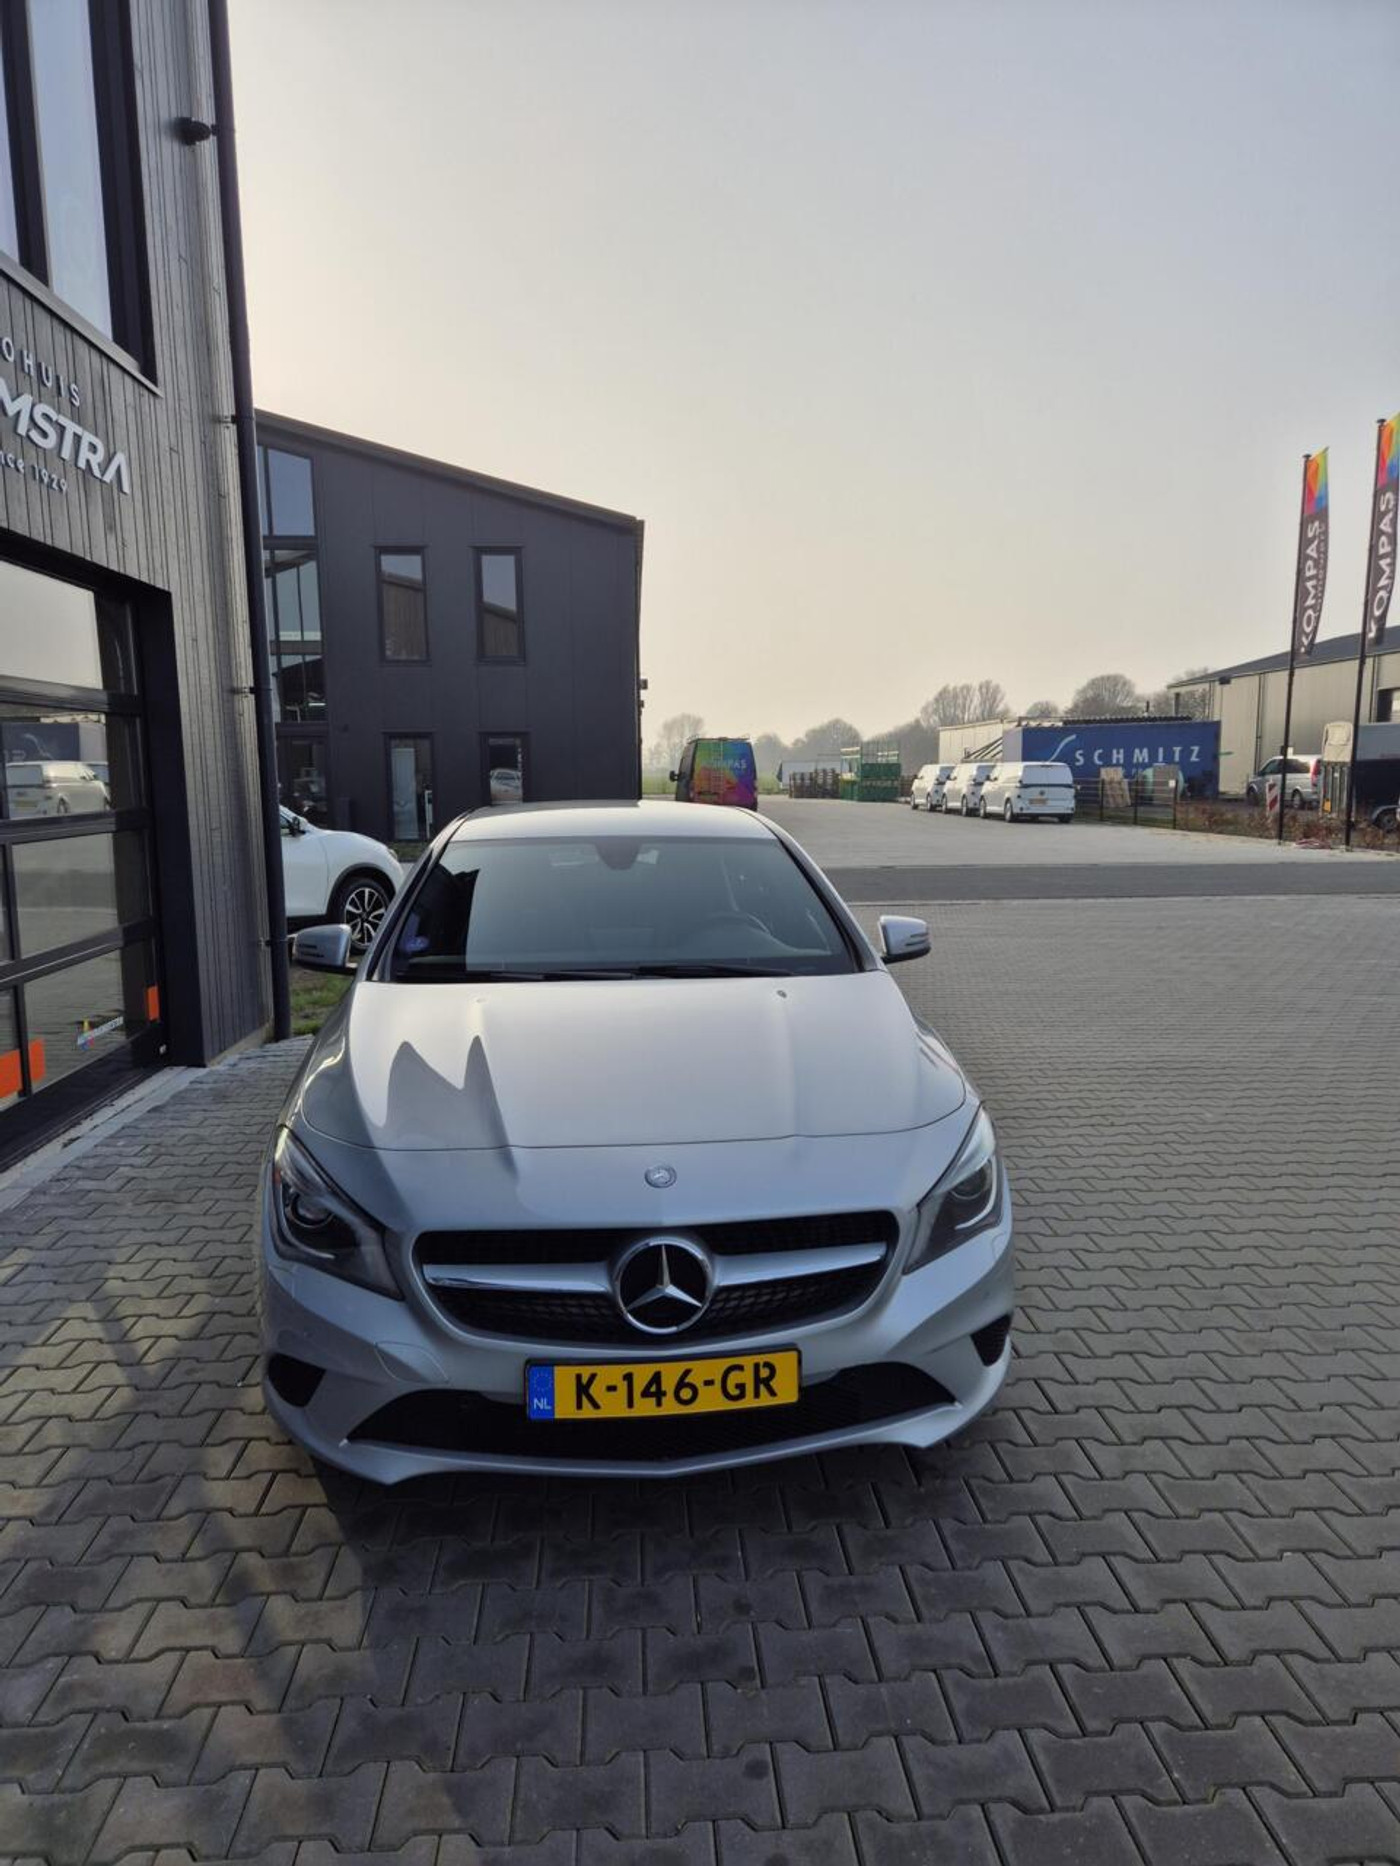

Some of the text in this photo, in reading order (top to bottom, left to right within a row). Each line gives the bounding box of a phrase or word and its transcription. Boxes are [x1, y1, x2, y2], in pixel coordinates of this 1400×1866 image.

[2, 337, 80, 408] OHUIS
[1075, 746, 1200, 766] SCHMITZ
[575, 1361, 778, 1411] K-146-GR
[533, 1398, 551, 1410] NL
